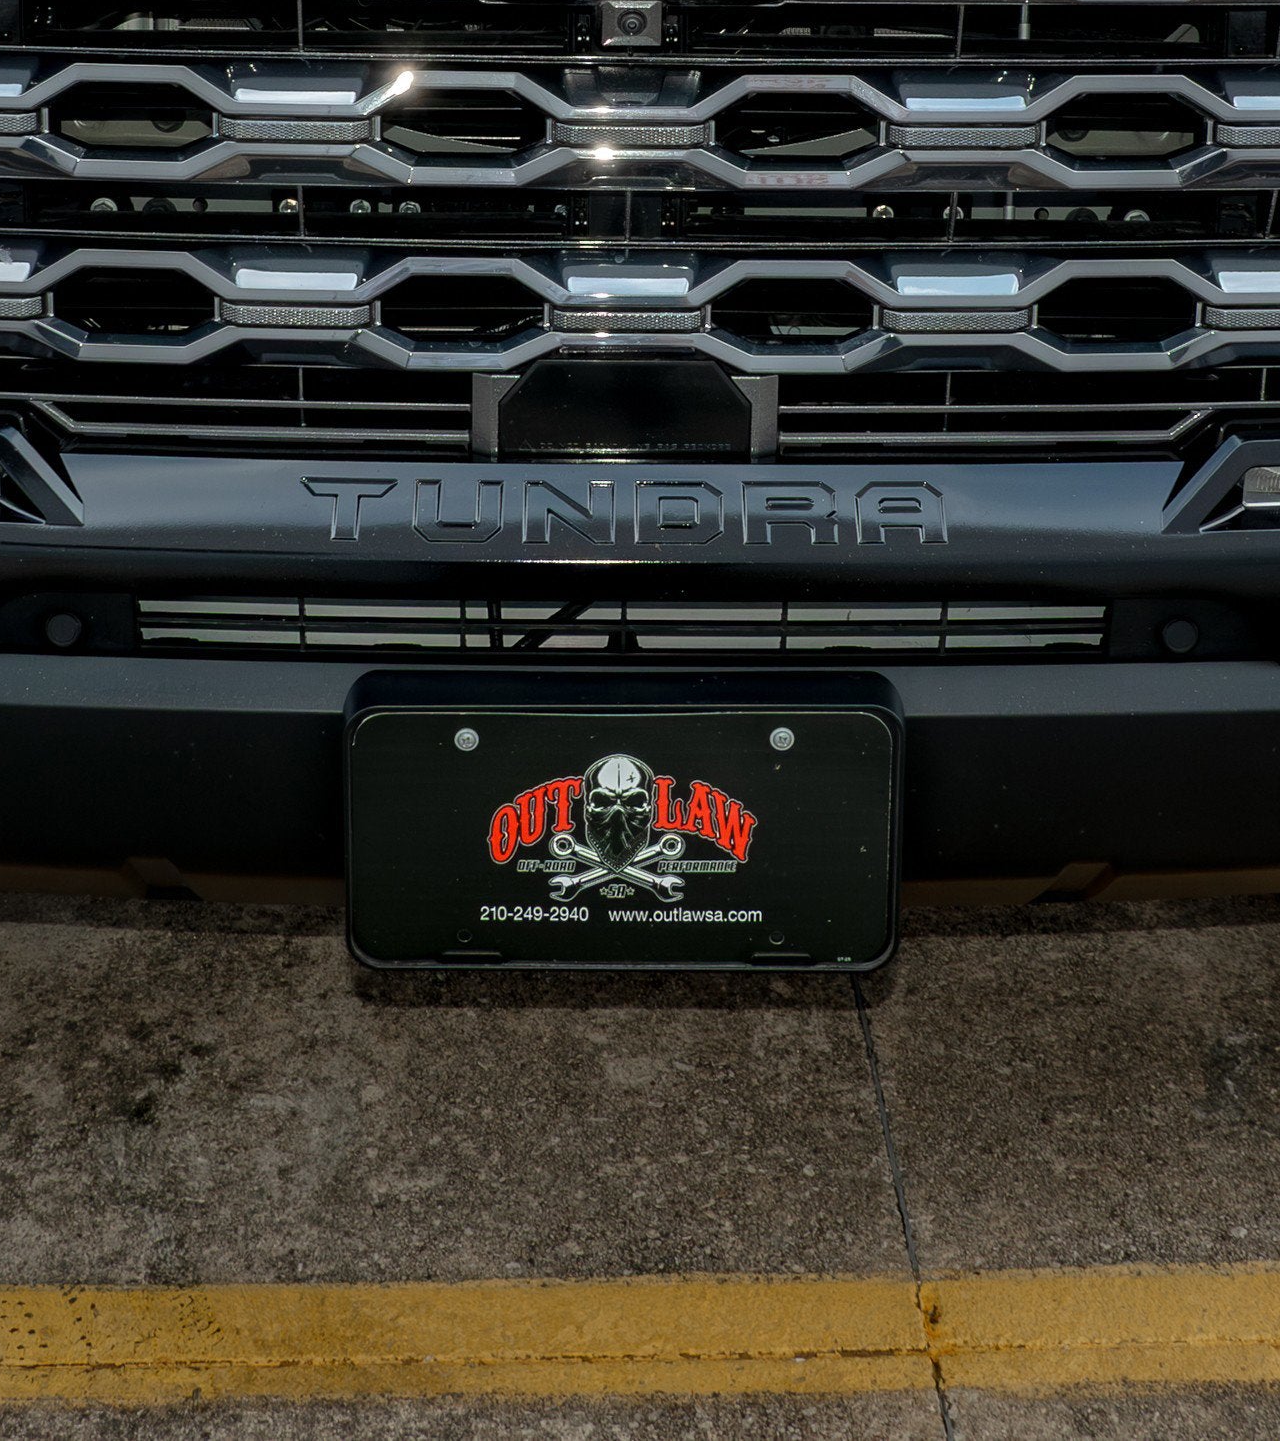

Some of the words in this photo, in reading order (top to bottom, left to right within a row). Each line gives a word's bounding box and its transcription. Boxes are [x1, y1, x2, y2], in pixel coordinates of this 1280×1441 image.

[302, 477, 949, 545] TUNDRA
[517, 859, 577, 873] OFF-ROAD
[657, 860, 737, 873] PERFORMANCE
[480, 905, 589, 922] 210-249-2940
[608, 906, 763, 923] www.outlawsa.com
